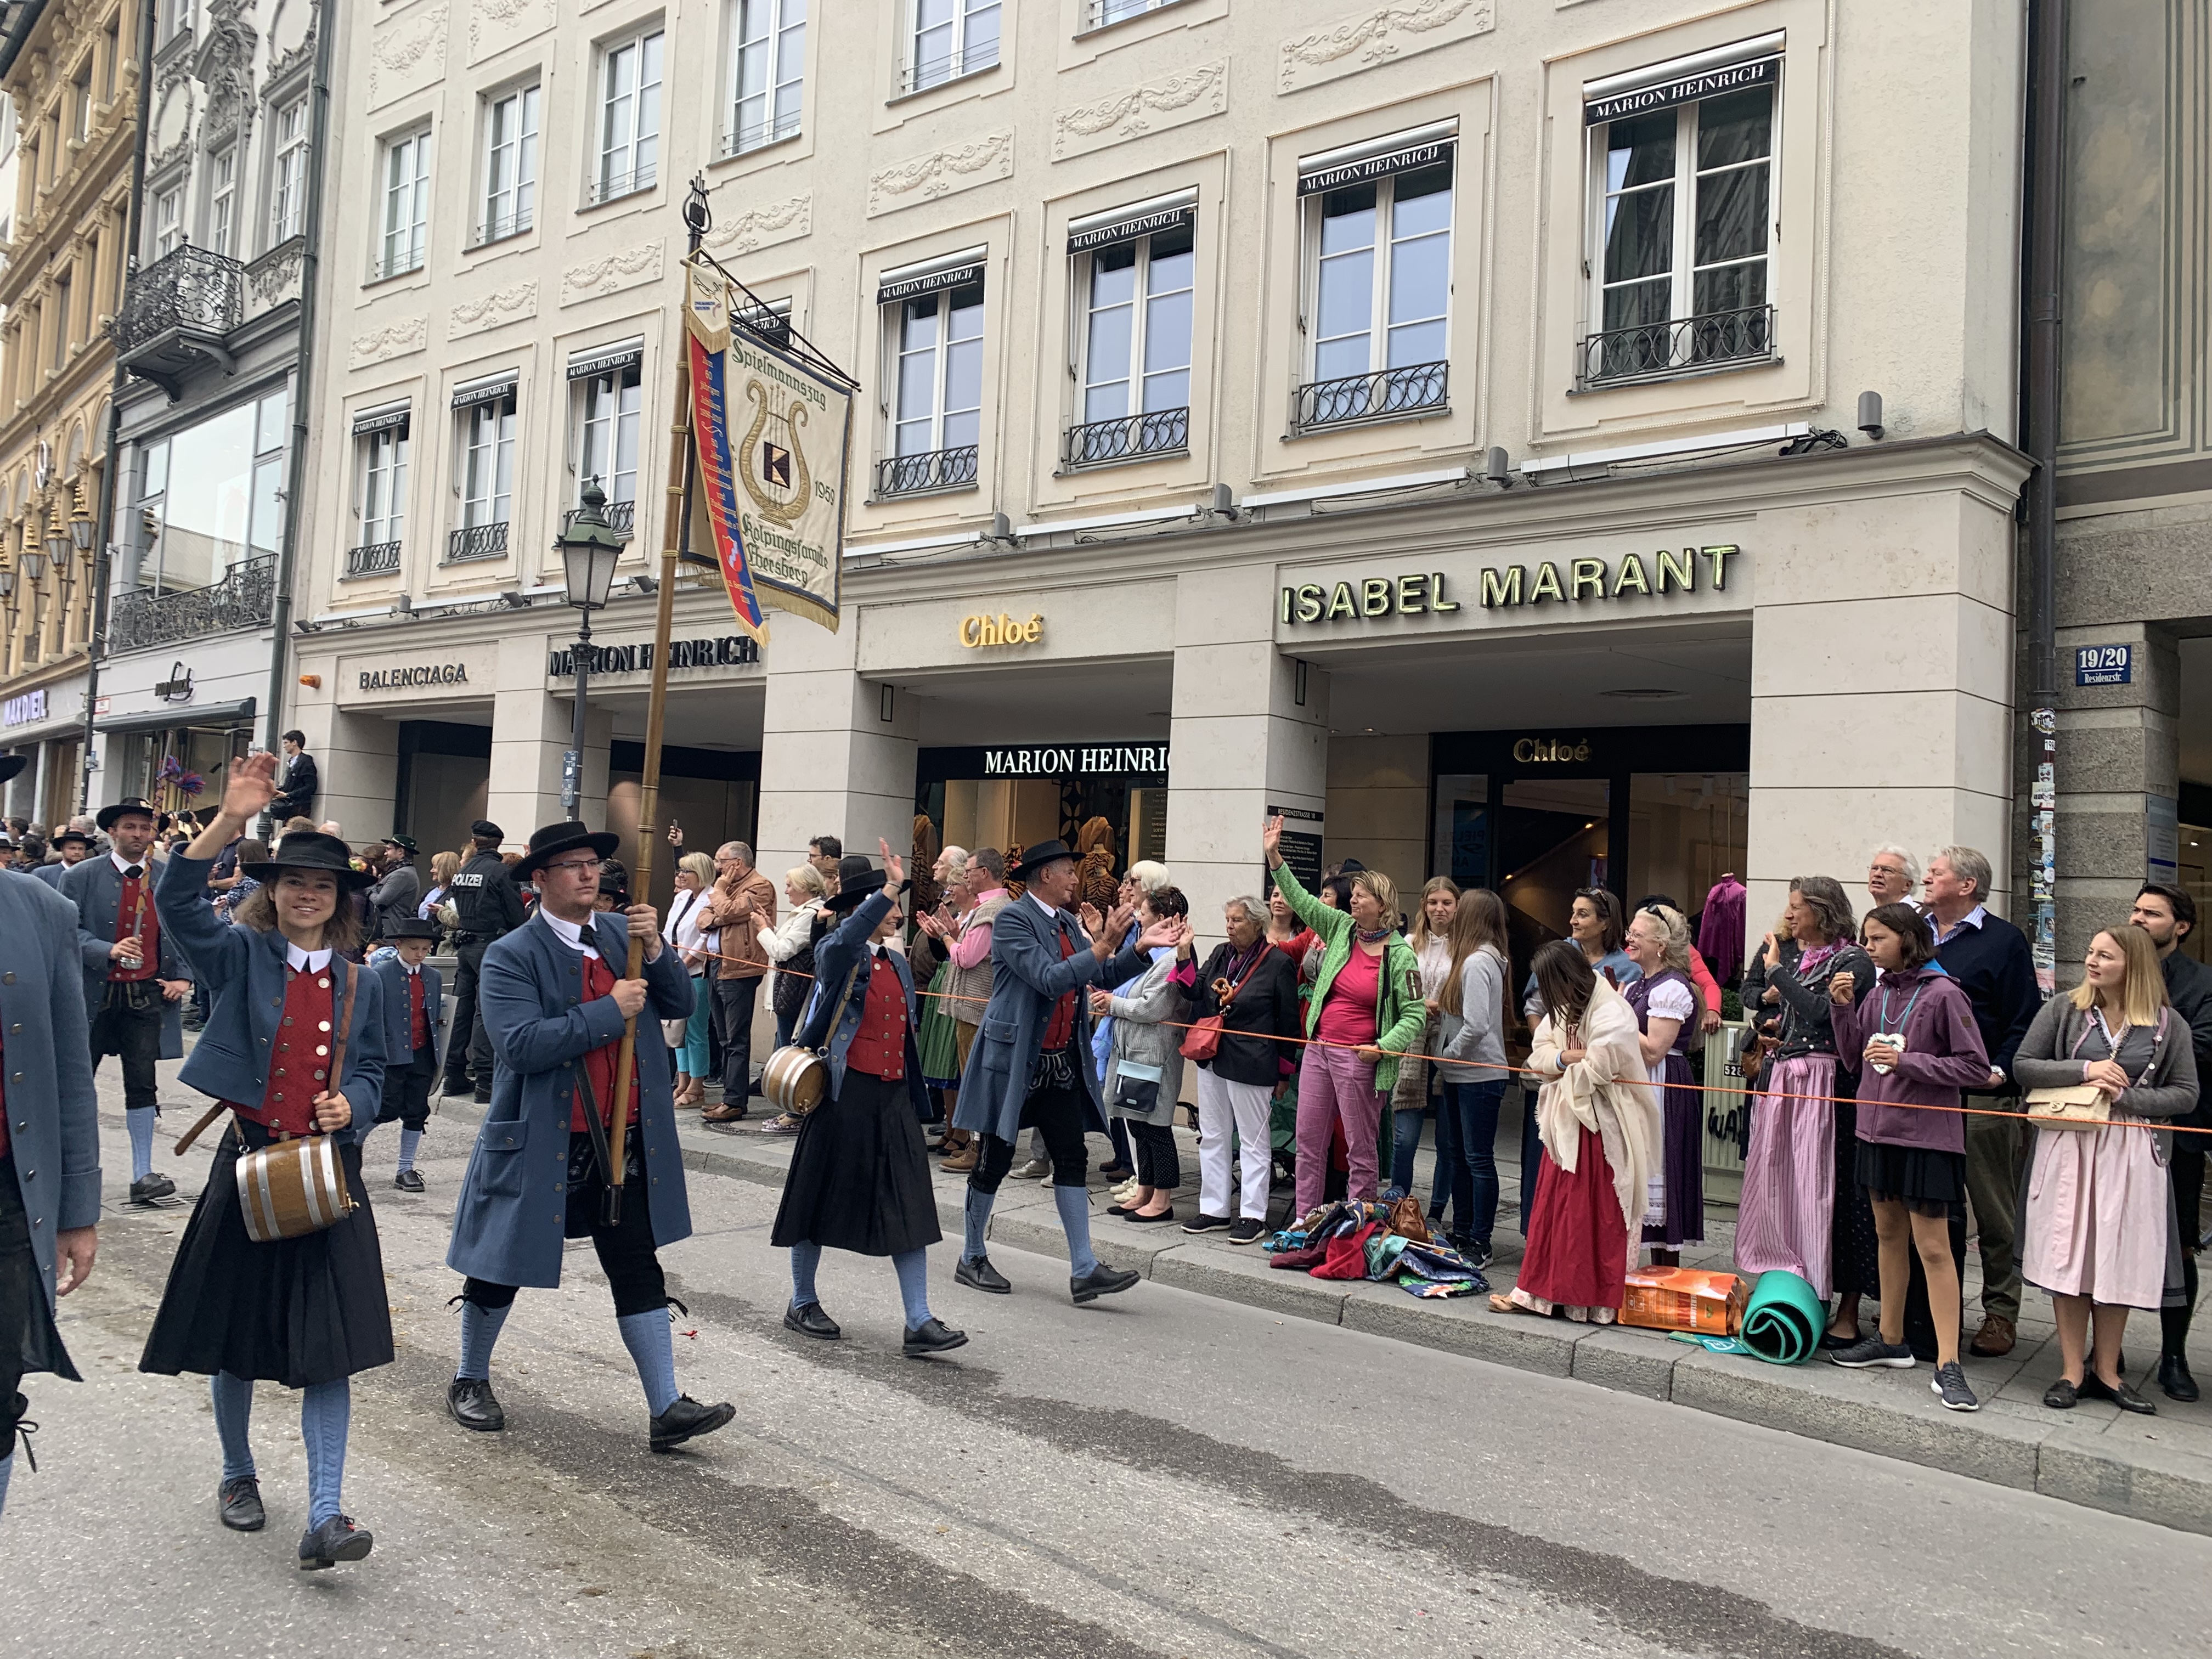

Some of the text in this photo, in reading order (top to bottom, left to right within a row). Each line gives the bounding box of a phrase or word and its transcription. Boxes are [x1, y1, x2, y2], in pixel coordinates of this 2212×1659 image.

[1595, 64, 1765, 118] MARION HEINRICH
[1305, 146, 1440, 191] MARION HEINRICH
[1072, 210, 1181, 248] MARION HEINRICH
[881, 268, 973, 298] MARION HEINRICH
[568, 353, 634, 376] MARION HEINRICH
[732, 338, 826, 411] Spielmannszug
[454, 384, 509, 405] MARION HEINRICH
[355, 421, 375, 432] MARION
[815, 480, 835, 505] 1959
[746, 541, 808, 588] Ebersberg
[1282, 544, 1740, 625] ISABEL MARANT
[959, 613, 1043, 648] Chloé
[636, 636, 759, 669] HINRICH
[2079, 647, 2127, 668] 19/20
[359, 663, 468, 690] BALENCIAGA
[2085, 672, 2122, 684] Residenzstr.
[985, 748, 1170, 774] MARION HEINRI
[1513, 737, 1590, 763] Chloé
[1278, 808, 1311, 819] RESIDENZSTRASSE
[451, 873, 483, 887] POLIZEI
